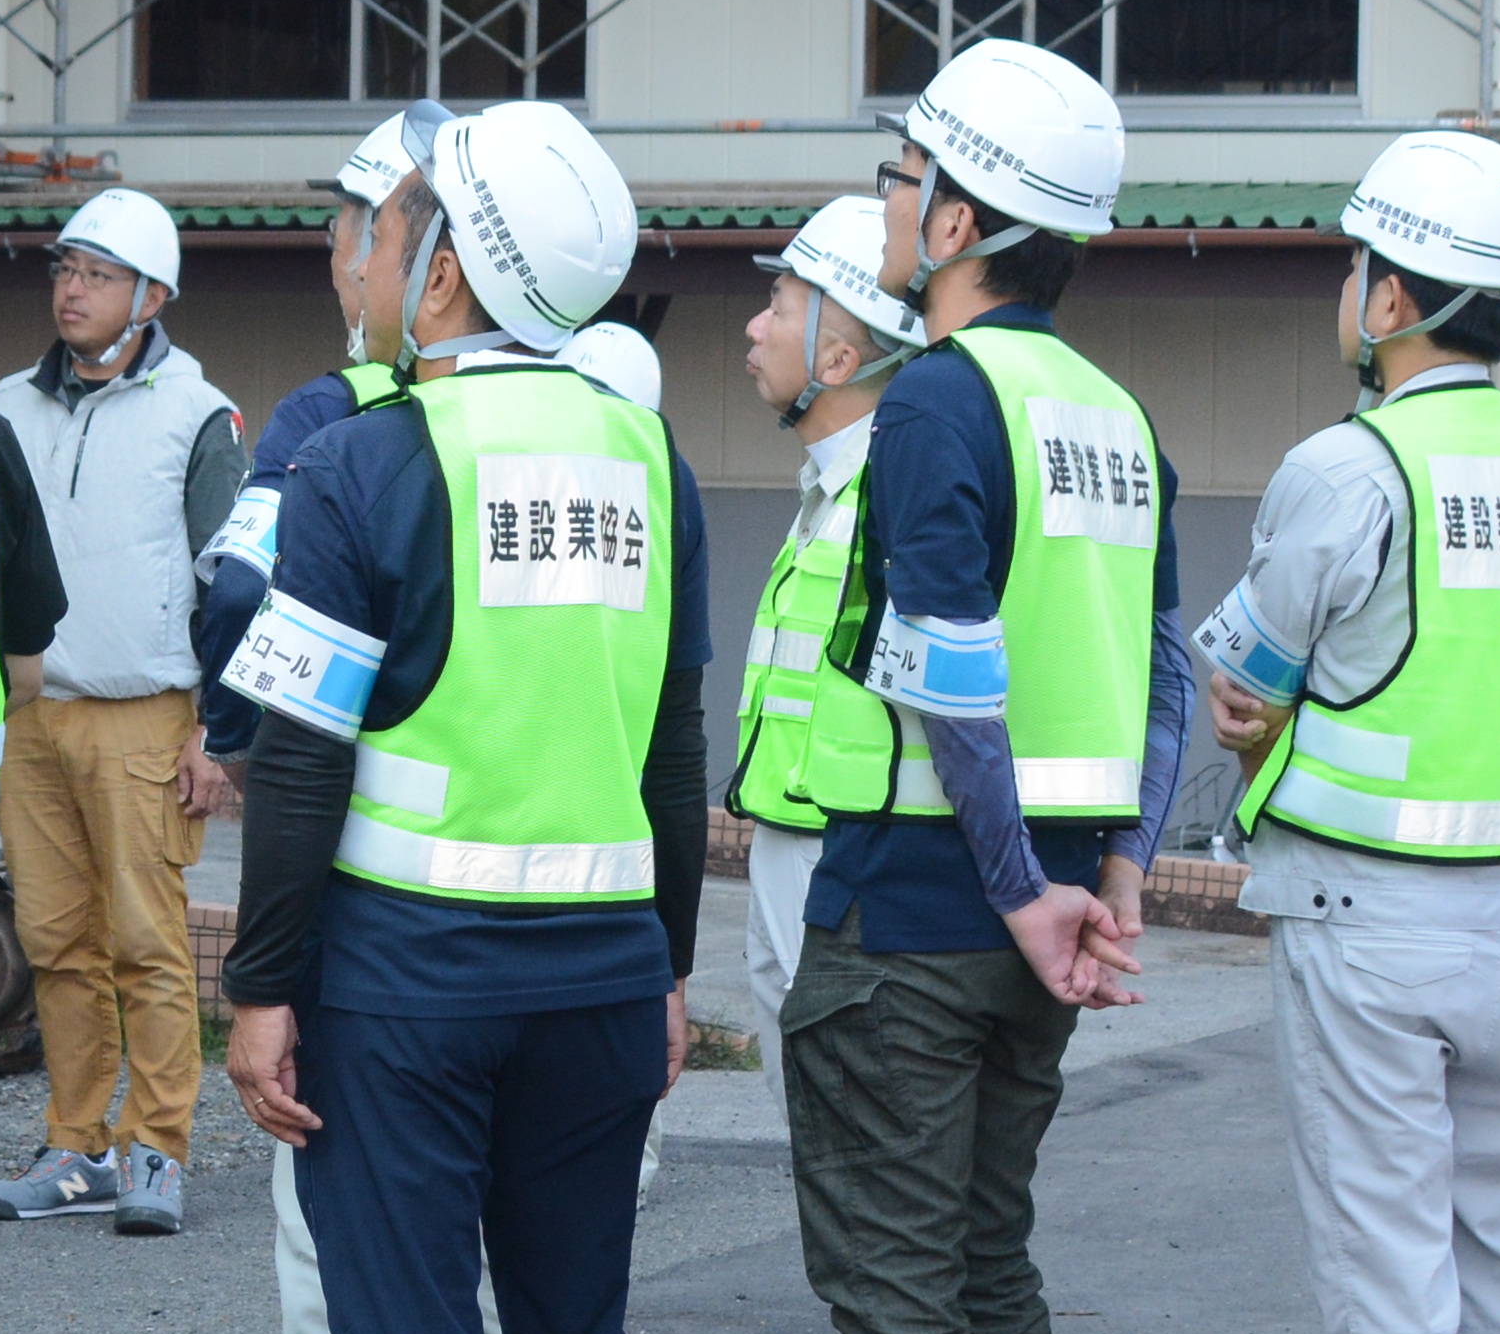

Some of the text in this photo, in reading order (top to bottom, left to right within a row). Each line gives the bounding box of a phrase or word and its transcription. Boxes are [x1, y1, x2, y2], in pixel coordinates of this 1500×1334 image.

[937, 108, 1027, 175] 鹿児島県建設業協会
[944, 133, 998, 174] 指宿支部
[468, 210, 512, 274] 指宿支部
[473, 178, 538, 289] 鹿児島県建設業協会
[1366, 196, 1454, 240] 鹿児島県建設業協会
[1044, 438, 1152, 510] 建設業協会
[487, 497, 645, 571] 建設業協会
[56, 1171, 90, 1201] N
